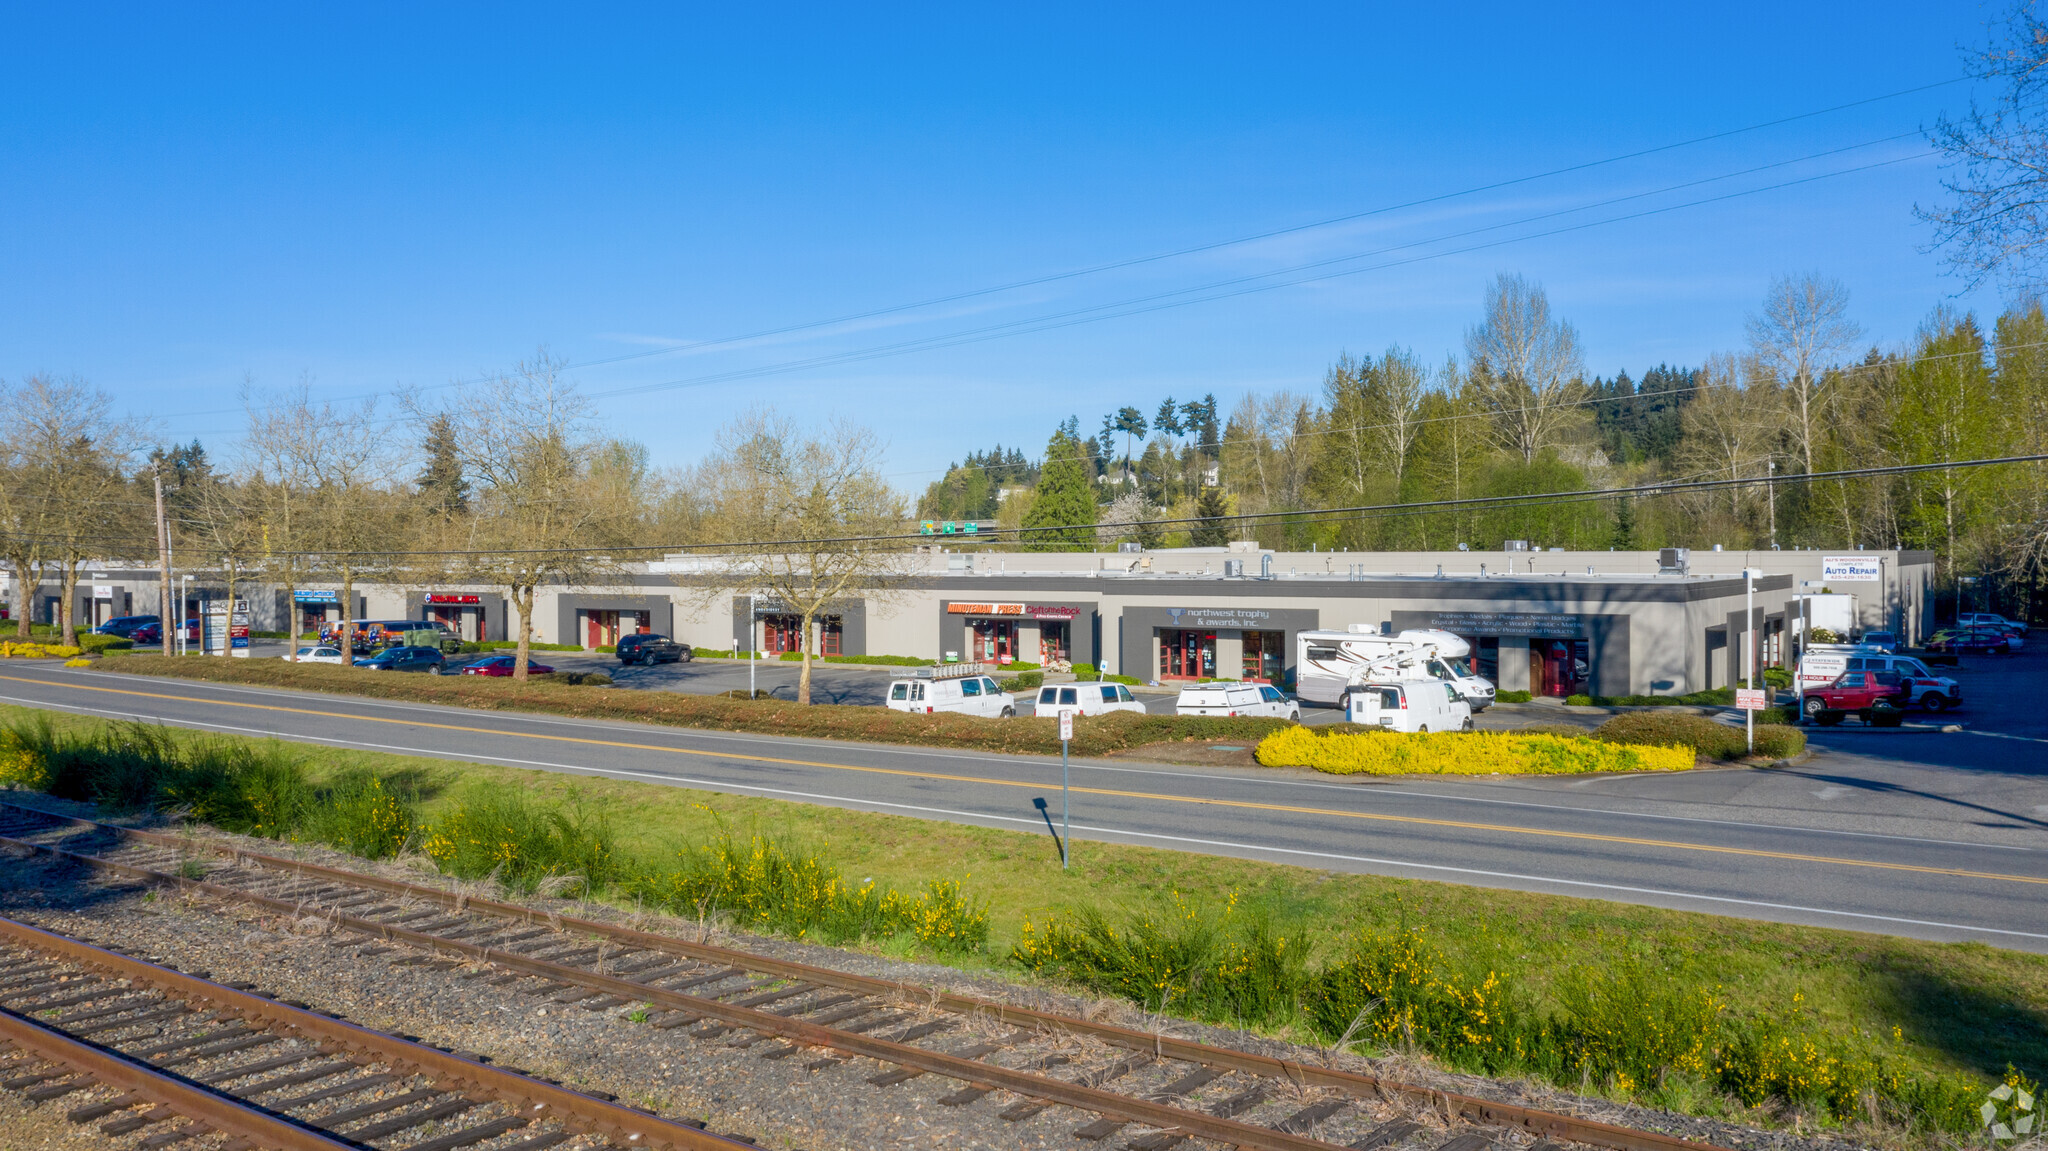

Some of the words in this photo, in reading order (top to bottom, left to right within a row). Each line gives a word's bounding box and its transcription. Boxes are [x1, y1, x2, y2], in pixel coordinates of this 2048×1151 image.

[947, 603, 993, 614] MINUTEMAN
[996, 604, 1024, 615] PRESS
[1026, 605, 1045, 615] Cleft
[1061, 606, 1081, 615] Rock
[1187, 609, 1235, 618] northwest
[1237, 610, 1270, 620] trophy
[1197, 618, 1205, 626] &
[1206, 618, 1242, 627] awards,
